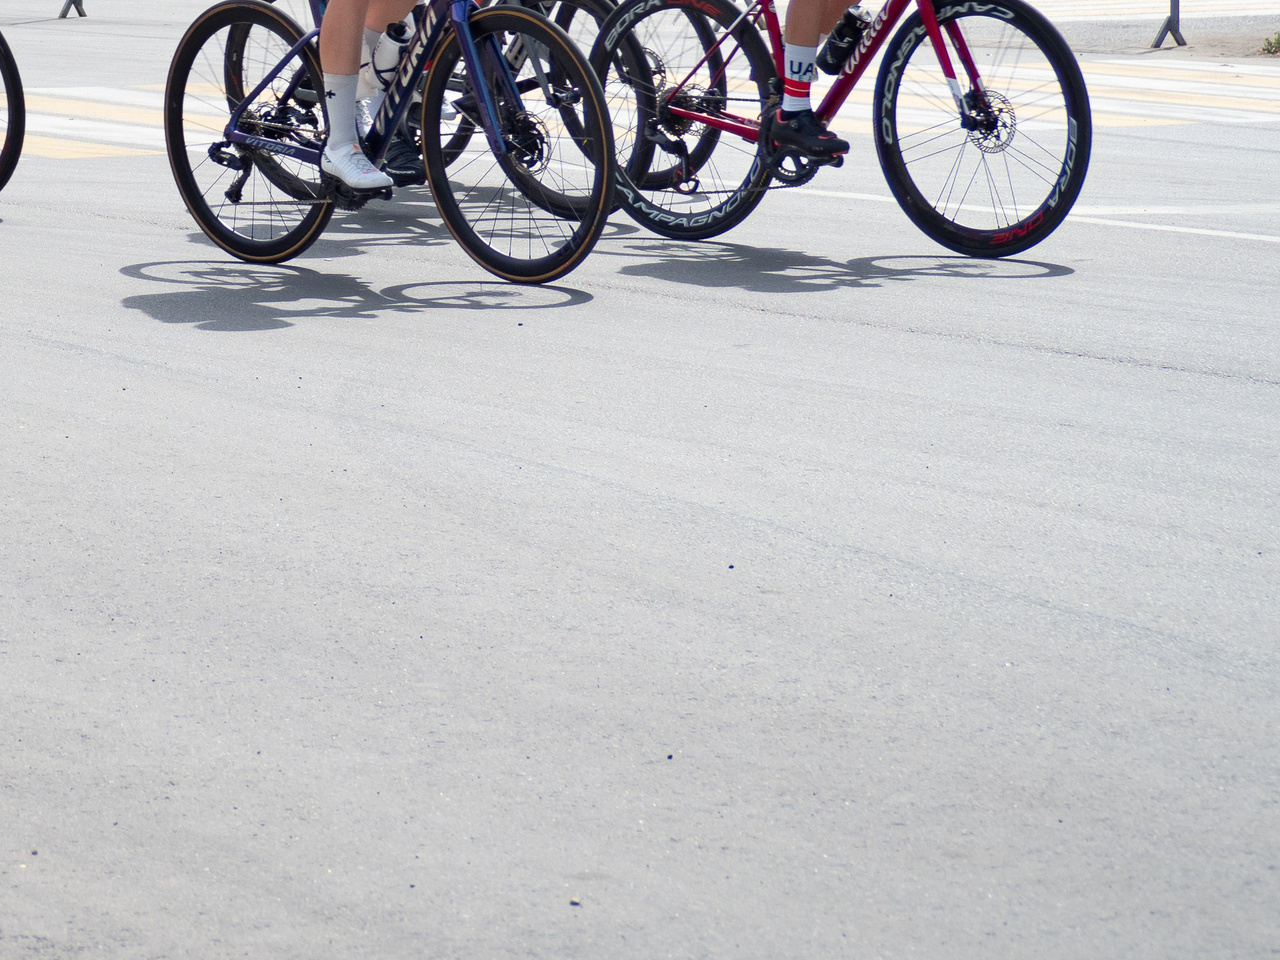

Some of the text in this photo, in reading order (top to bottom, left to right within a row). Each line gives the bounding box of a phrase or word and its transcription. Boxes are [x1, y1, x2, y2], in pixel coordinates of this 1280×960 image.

[375, 4, 437, 136] VITORIA
[245, 137, 297, 155] VITORIA
[989, 116, 1078, 245] BORA ONE
